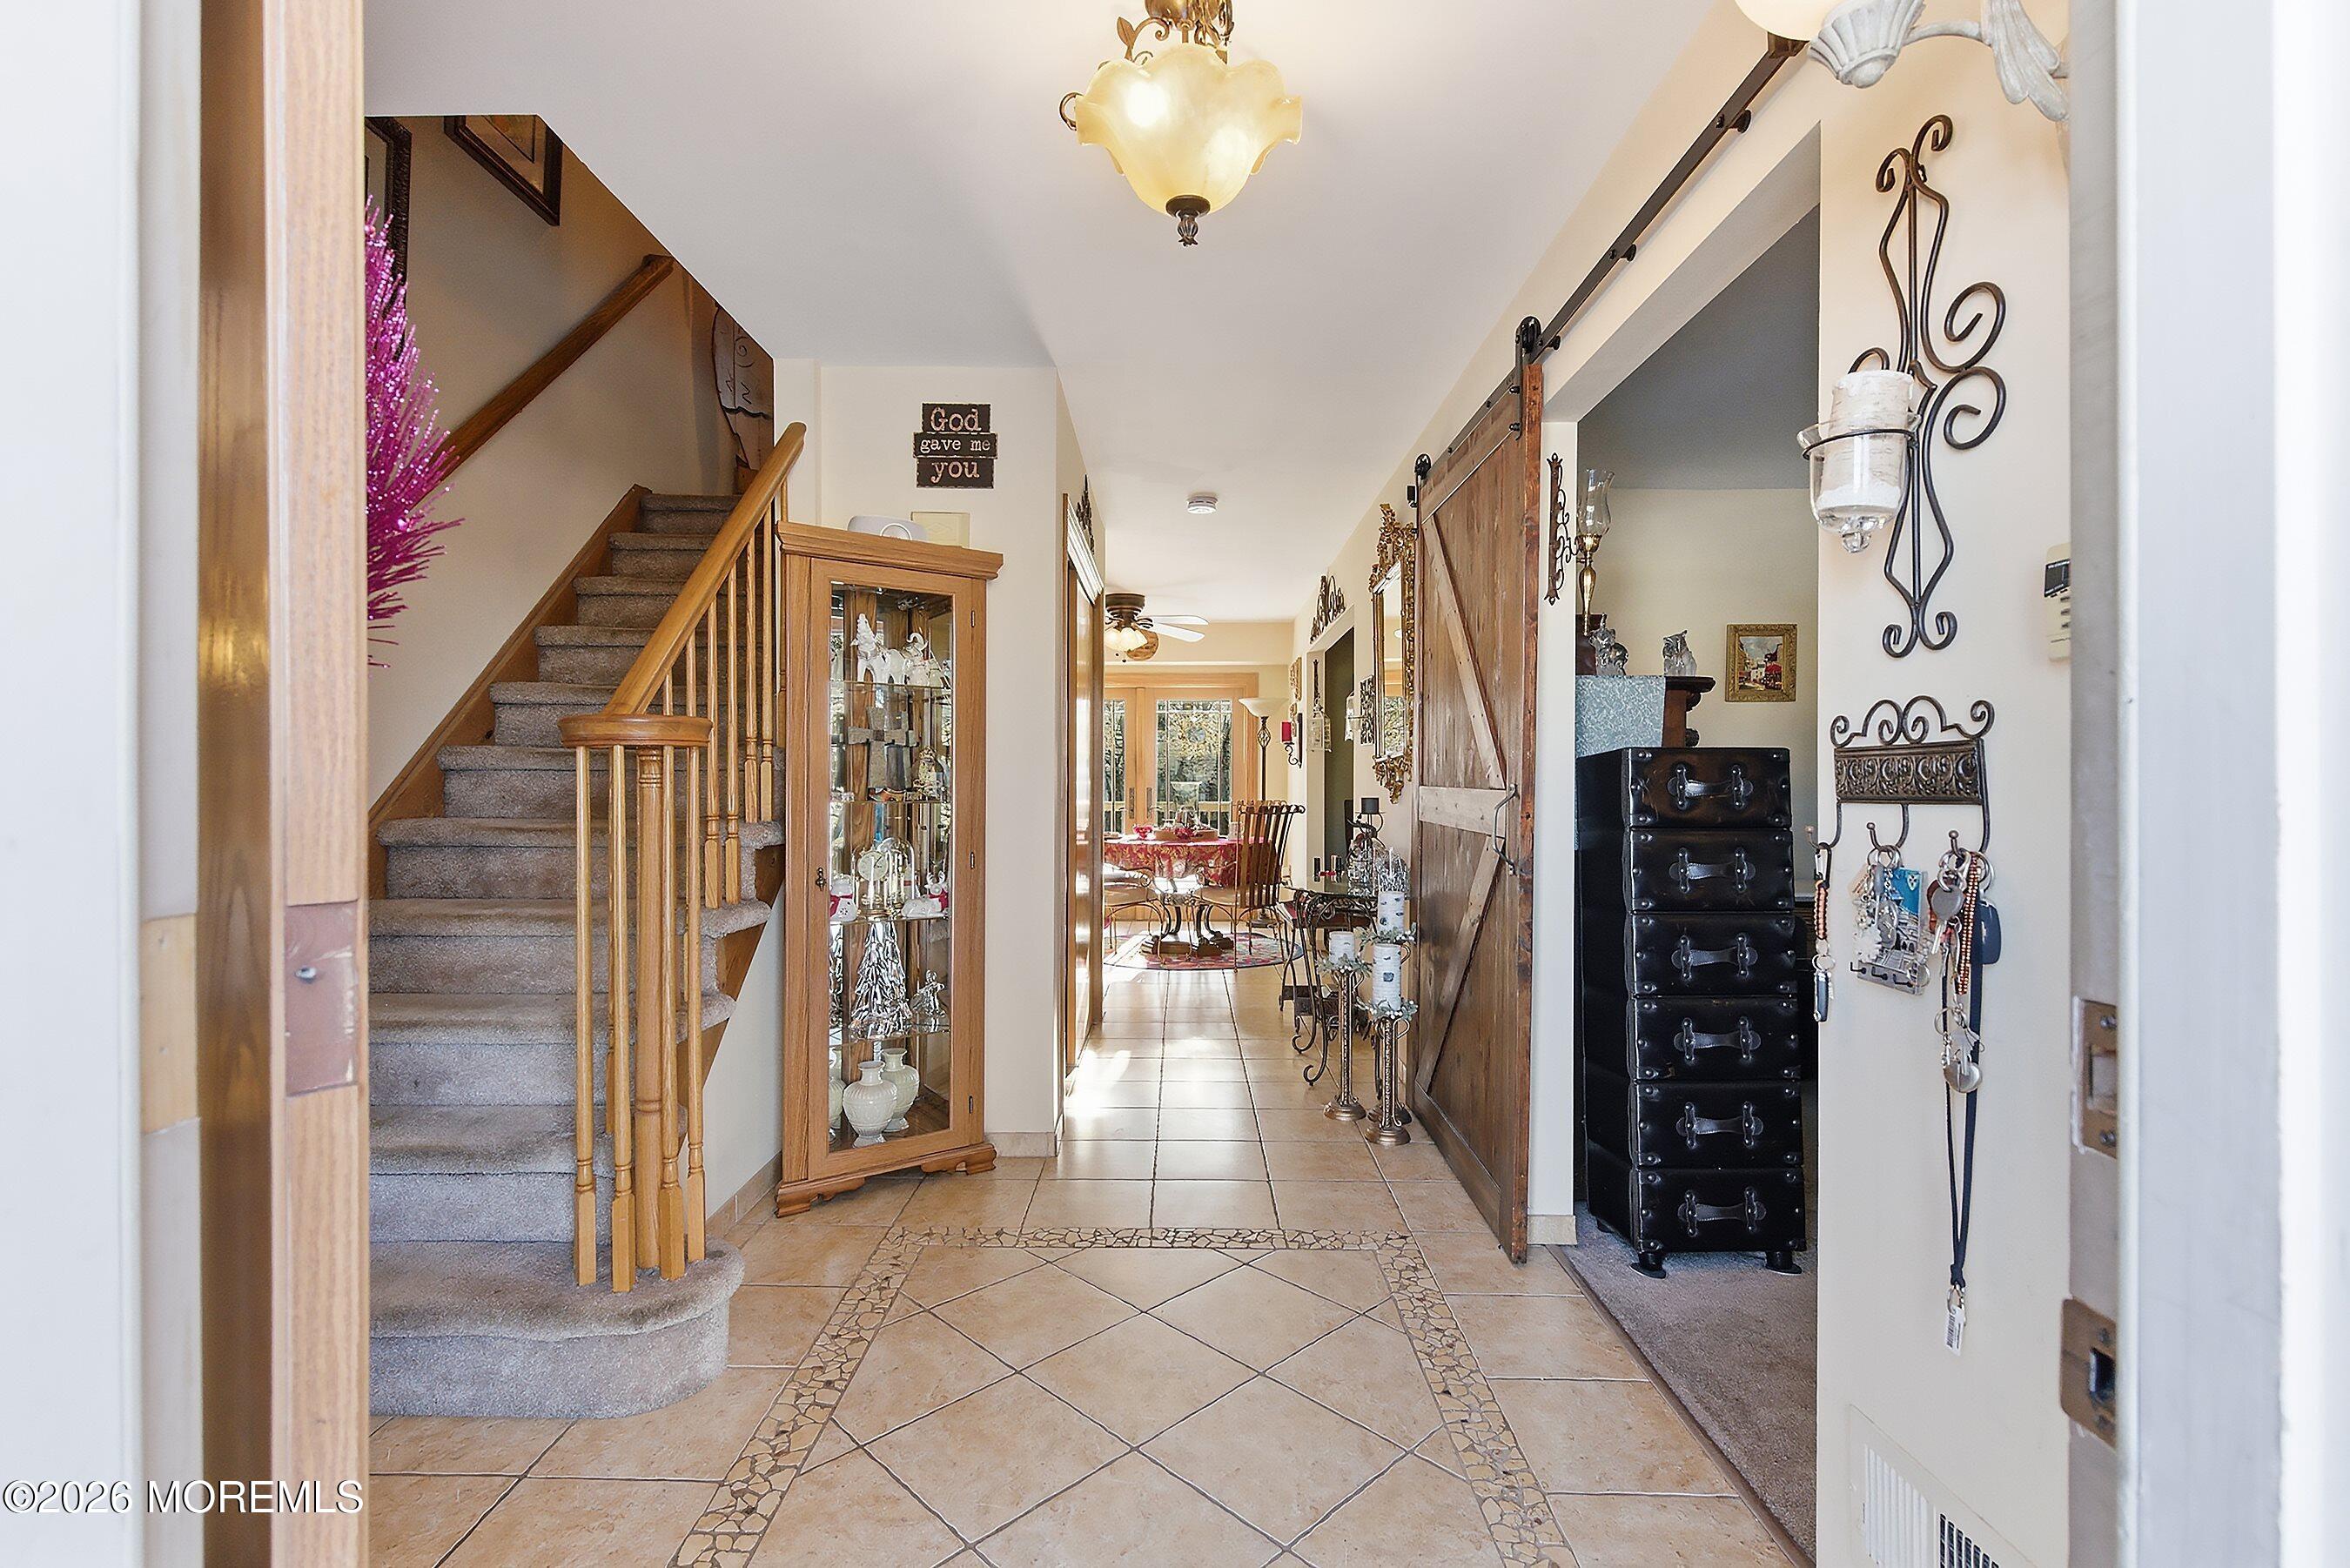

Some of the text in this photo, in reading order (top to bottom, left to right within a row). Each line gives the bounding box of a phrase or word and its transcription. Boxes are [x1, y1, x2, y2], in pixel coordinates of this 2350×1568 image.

[930, 407, 982, 432] God
[920, 439, 990, 453] gave me
[930, 462, 980, 483] you
